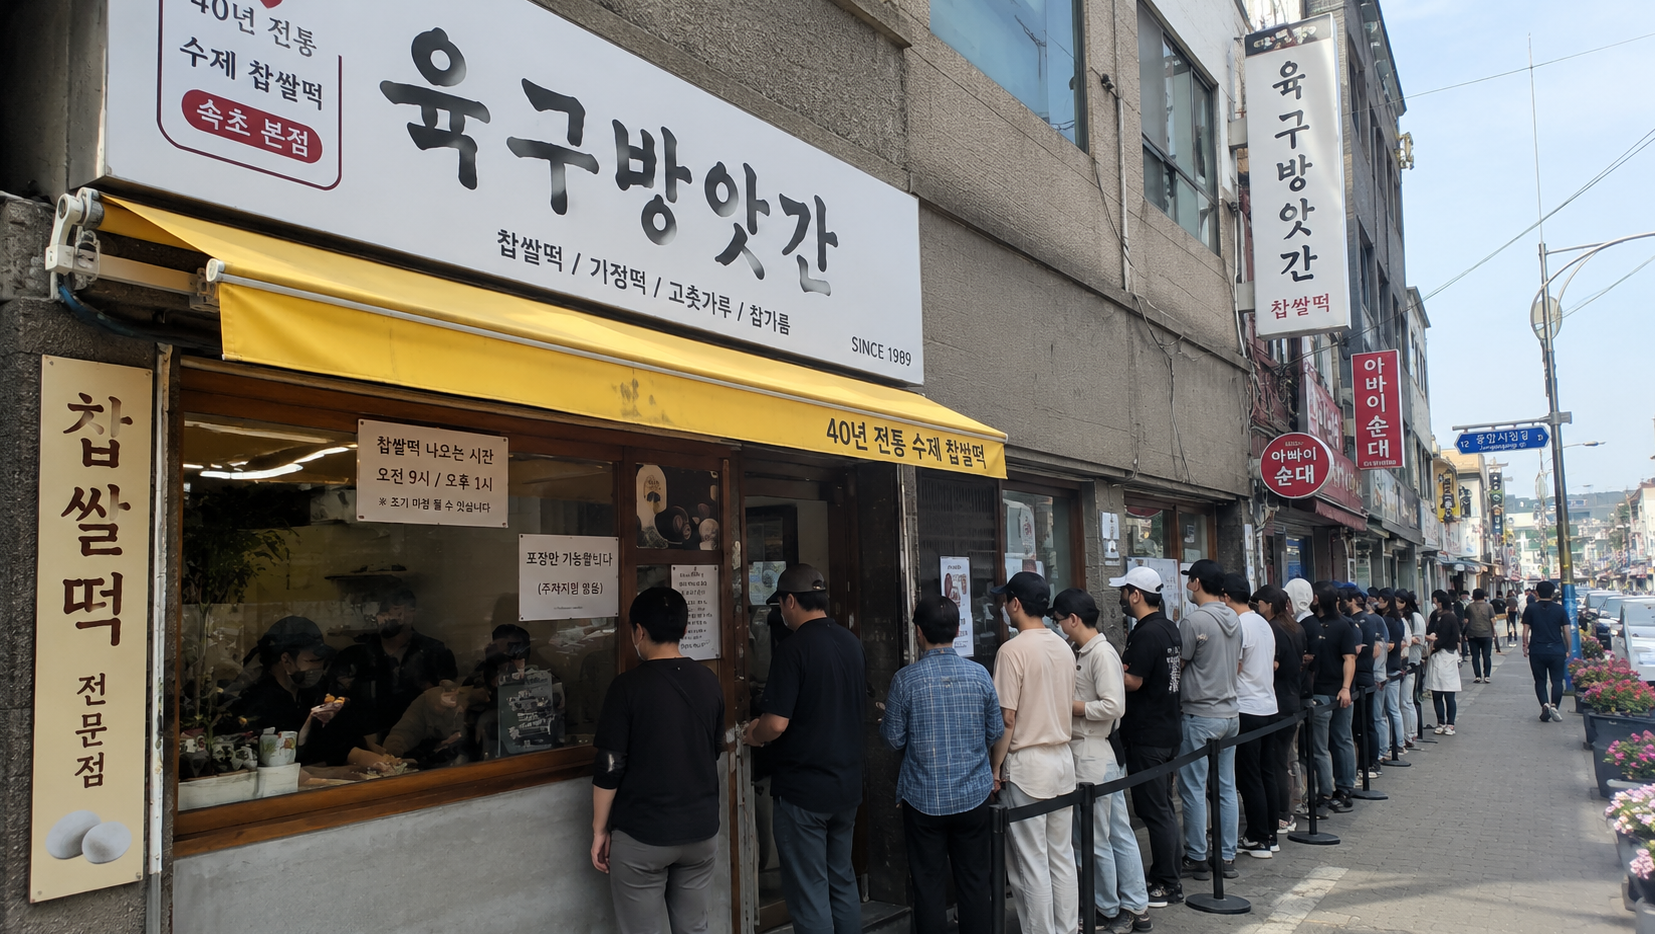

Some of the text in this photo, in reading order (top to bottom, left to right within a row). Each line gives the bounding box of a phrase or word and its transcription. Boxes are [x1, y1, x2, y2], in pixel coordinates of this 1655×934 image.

[267, 17, 317, 58] 전통
[179, 36, 323, 112] 수제 찹쌀떡
[196, 98, 309, 158] 속초 본점
[379, 26, 840, 297] 육구방앗간
[1272, 60, 1319, 284] 육구방앗간
[496, 228, 563, 273] 찹쌀떡
[590, 257, 647, 296] 가정떡
[668, 280, 733, 319] 고춧가루
[1270, 293, 1331, 321] 찹쌀떡
[851, 336, 912, 367] SINCE 1989
[377, 435, 421, 457] 찹쌀떡
[426, 442, 465, 462] 나오는
[826, 417, 869, 451] 40년
[874, 425, 906, 458] 전통
[912, 432, 943, 462] 수제
[376, 467, 404, 485] 오전
[408, 470, 430, 487] 9시
[445, 473, 470, 491] 오후
[474, 476, 493, 492] 1시
[526, 551, 559, 567] 포장만
[60, 391, 133, 790] 찹쌀떡 전문점
